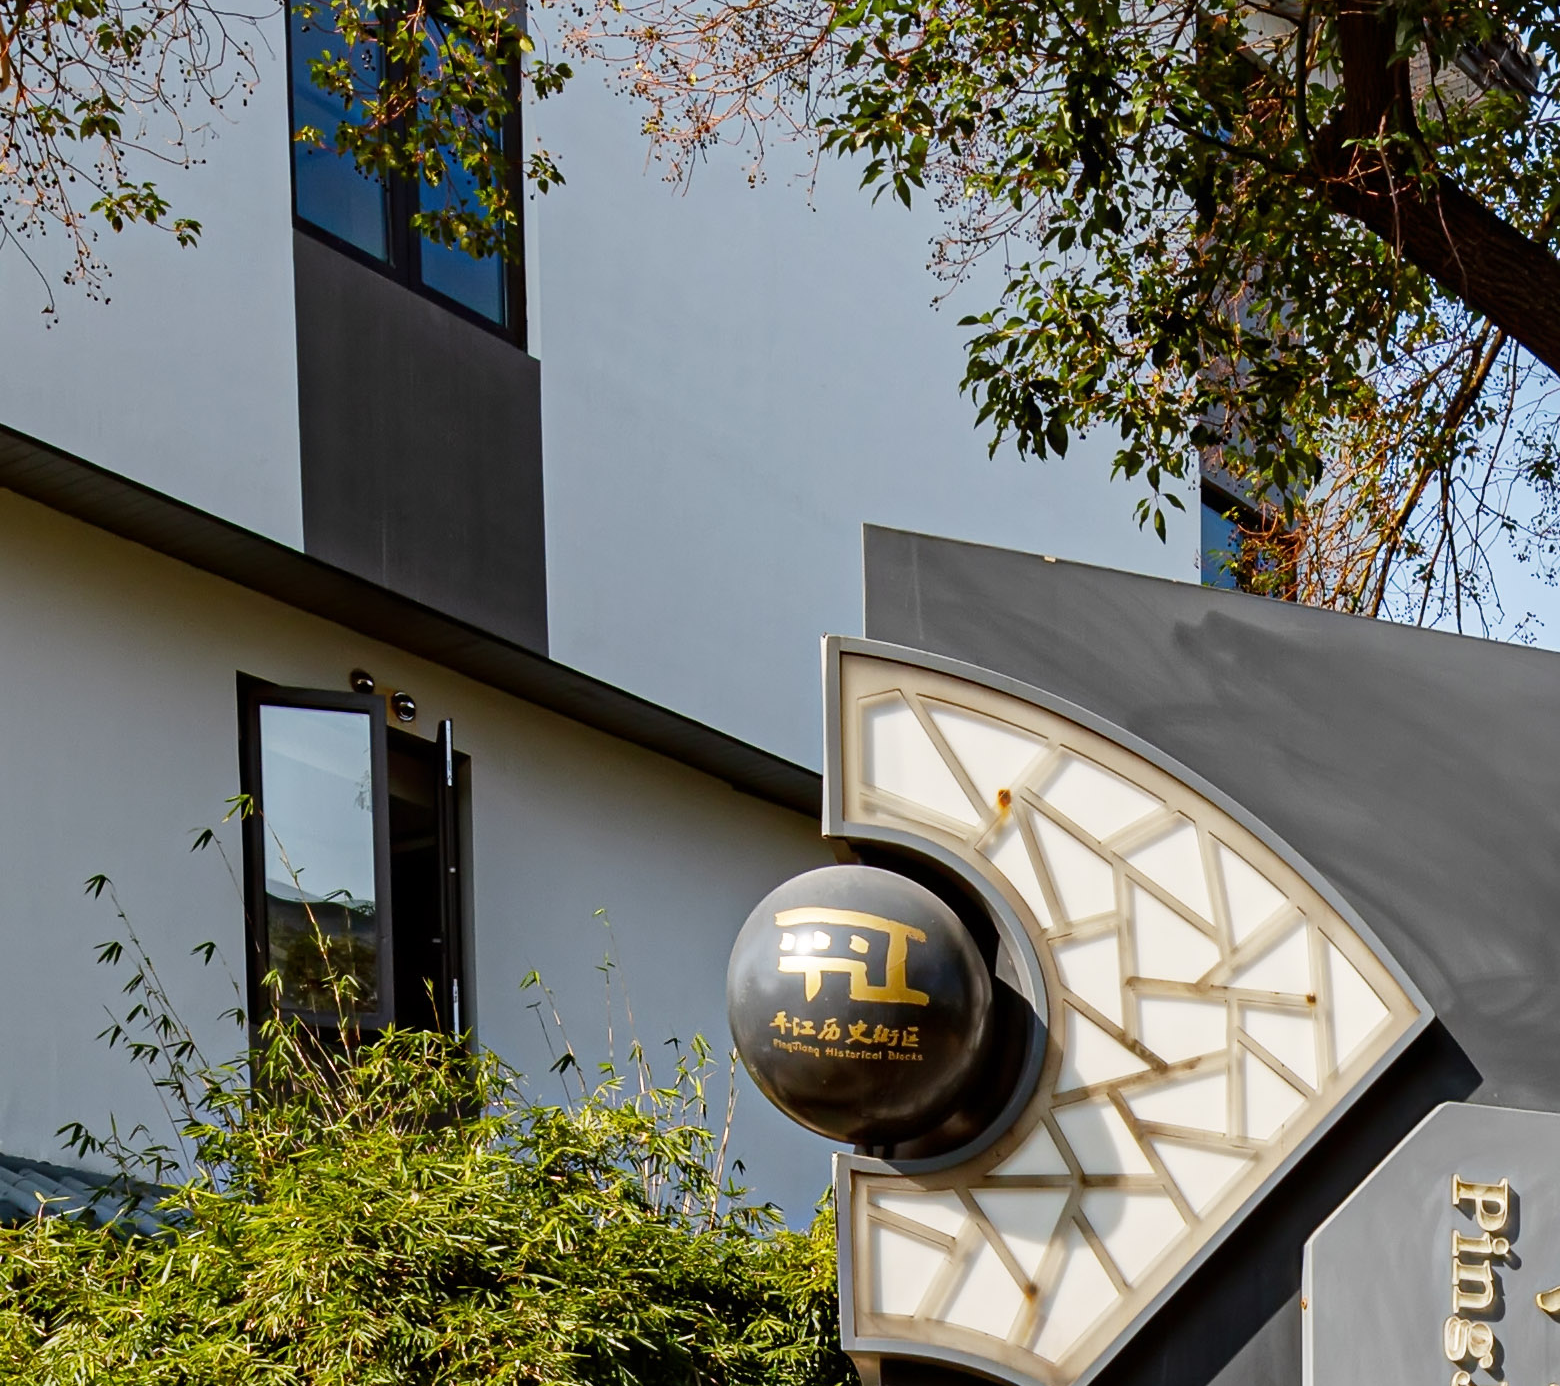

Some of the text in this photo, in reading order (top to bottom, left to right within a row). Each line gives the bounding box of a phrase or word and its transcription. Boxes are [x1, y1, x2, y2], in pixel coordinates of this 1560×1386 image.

[769, 1011, 919, 1047] 平江历史街区
[888, 1050, 924, 1062] Blocks
